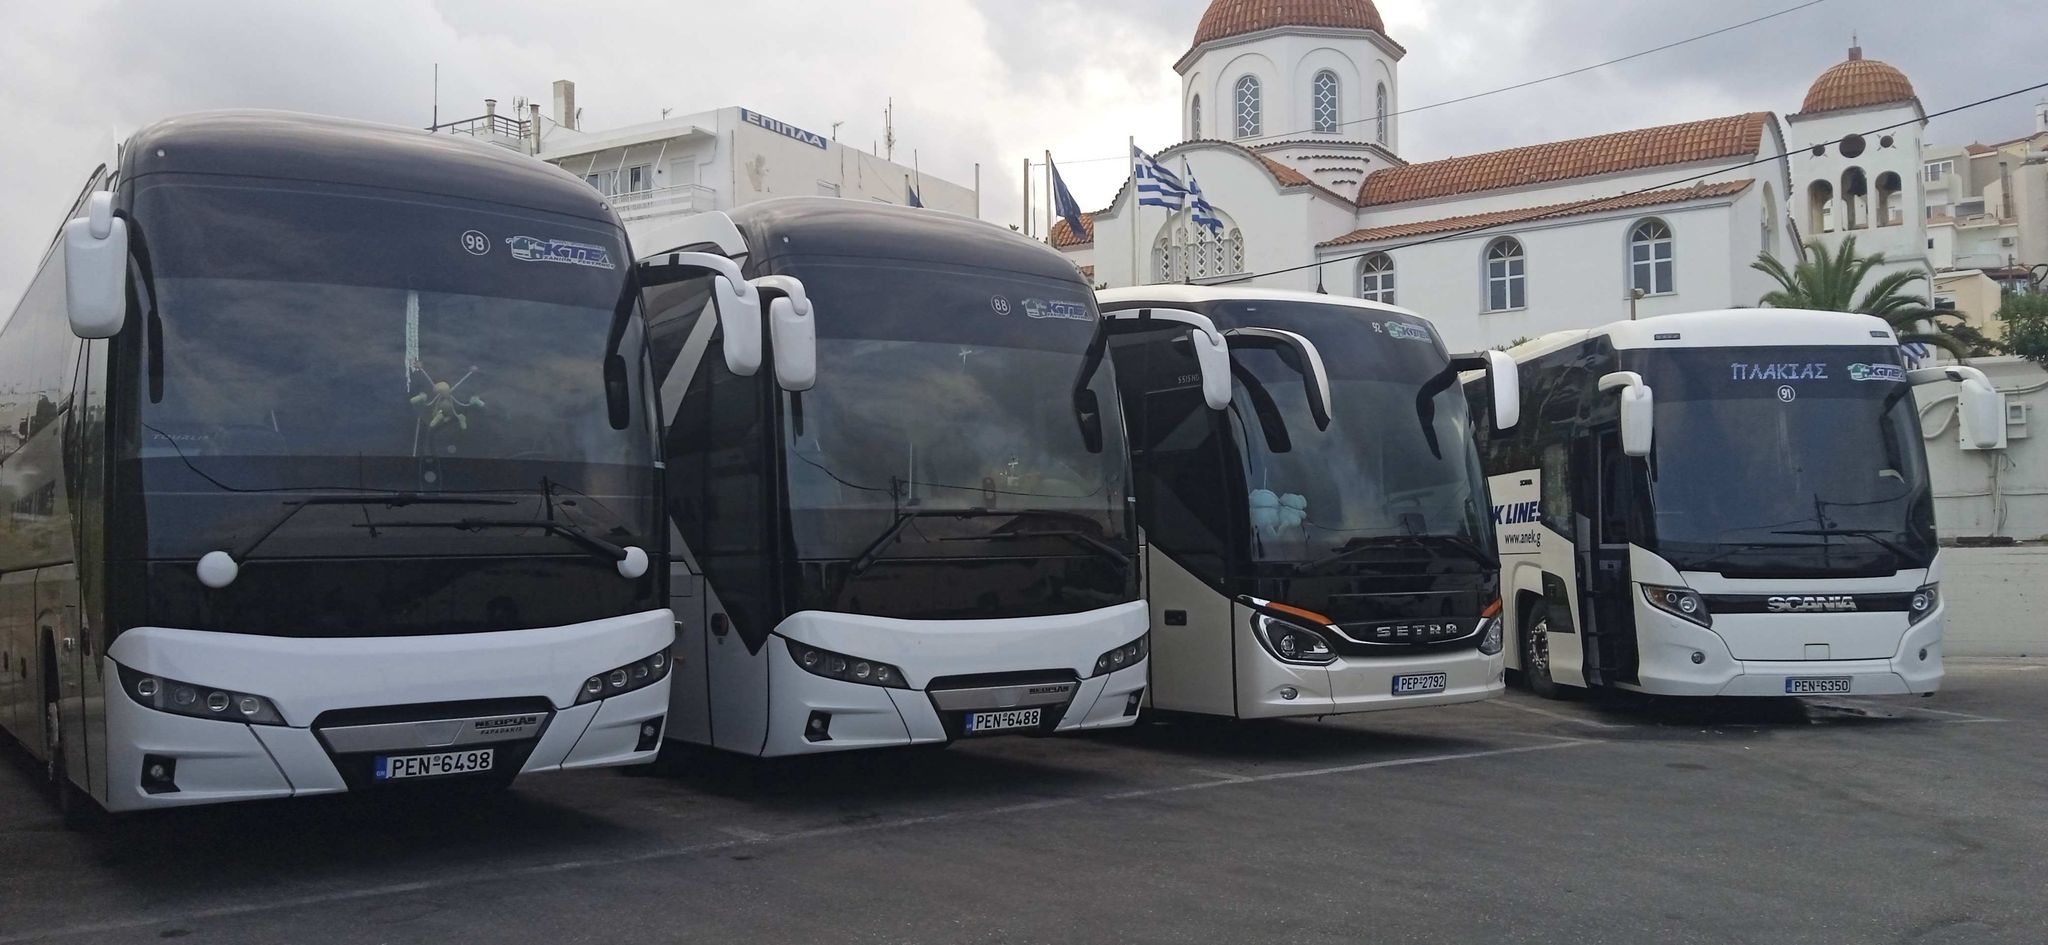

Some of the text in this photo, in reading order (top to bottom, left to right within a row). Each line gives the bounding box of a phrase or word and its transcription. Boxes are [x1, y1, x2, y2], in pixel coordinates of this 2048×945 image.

[746, 110, 823, 148] ΕΠΙΠΛΑ
[465, 235, 485, 251] 98
[994, 298, 1007, 312] 88
[1371, 321, 1383, 334] 92
[1730, 362, 1829, 381] ΠΛΑΚΙΑΣ
[1781, 388, 1792, 400] 91
[1492, 504, 1505, 525] K
[1766, 596, 1858, 612] SCANIA
[1376, 622, 1457, 638] SETRA
[475, 716, 537, 729] NEOPLAN
[976, 710, 1039, 730] PEN-6488
[391, 751, 491, 778] PEN-6498
